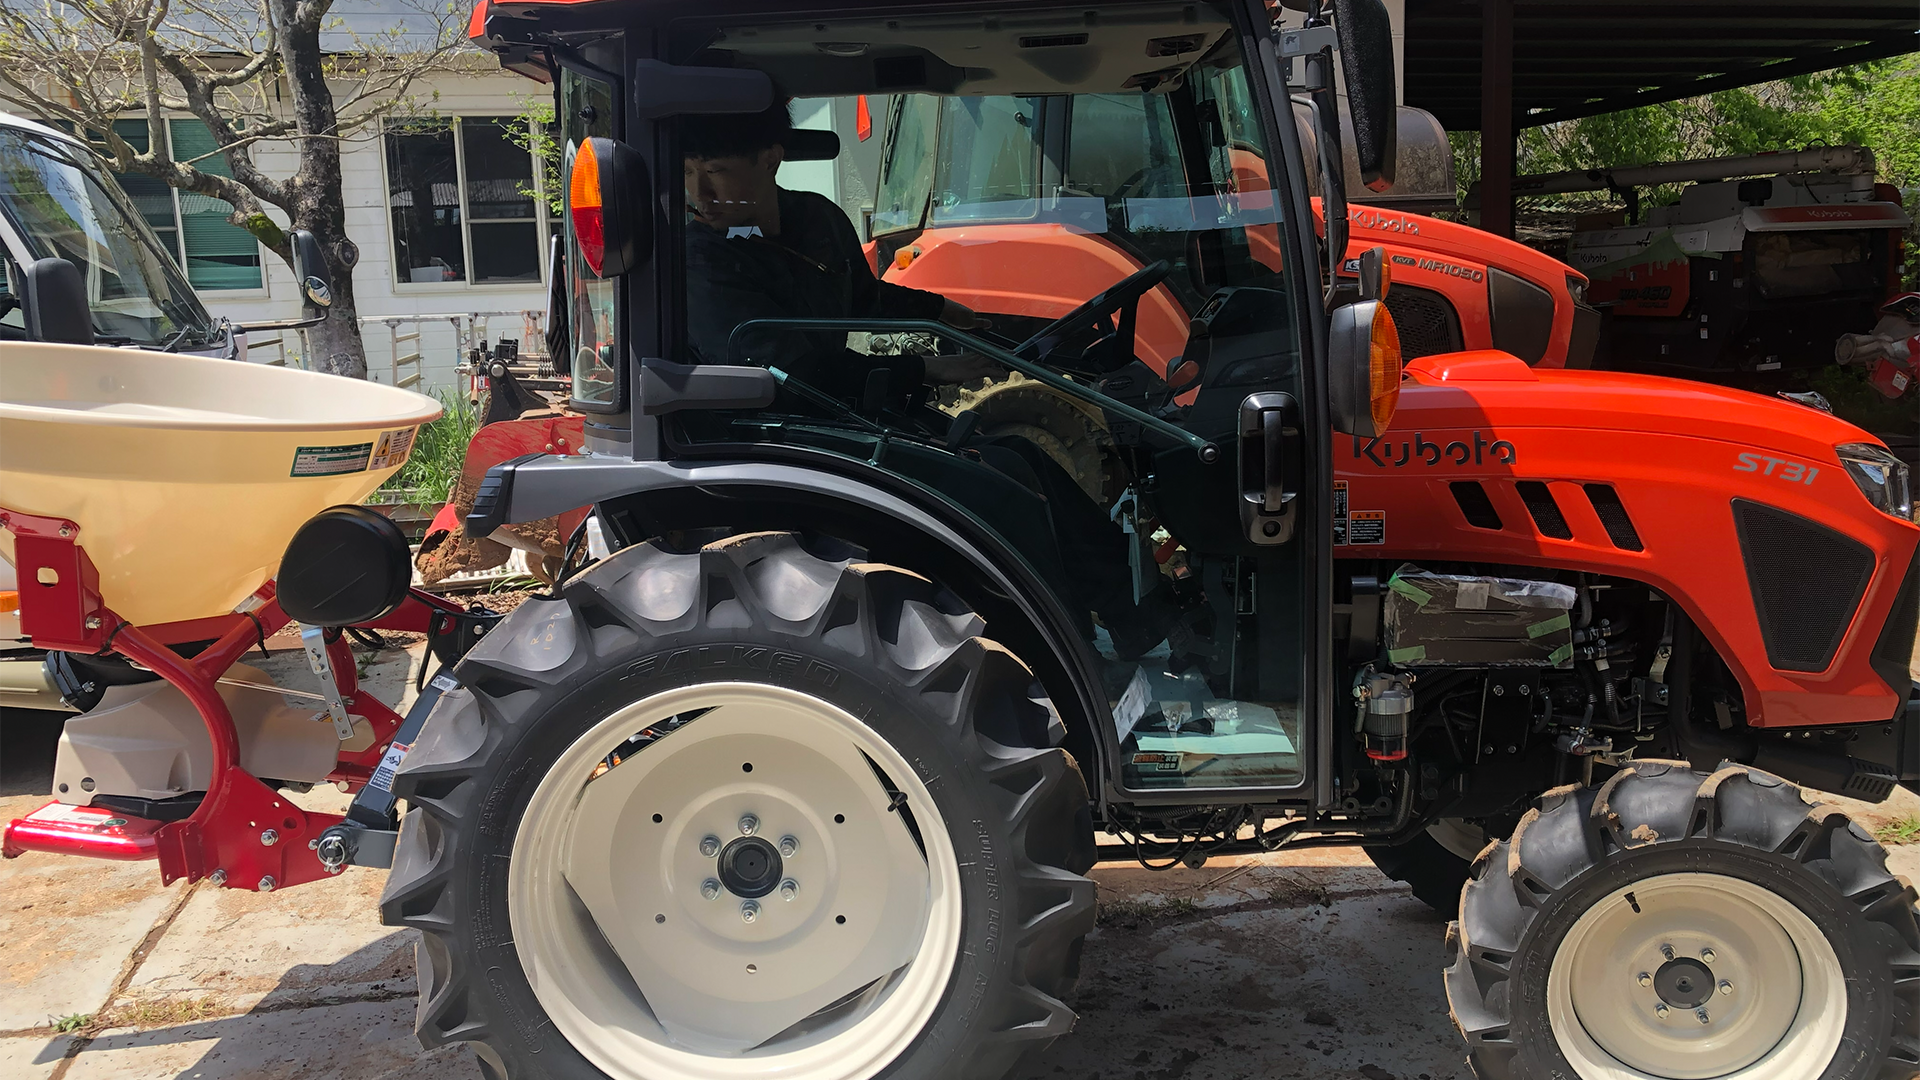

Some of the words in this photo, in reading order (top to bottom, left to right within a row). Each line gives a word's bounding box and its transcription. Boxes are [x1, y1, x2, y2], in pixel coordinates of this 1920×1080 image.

[1350, 210, 1419, 235] Kubota
[1418, 257, 1483, 282] MR1050
[1581, 253, 1607, 263] Kubota
[1353, 431, 1516, 467] Kubota
[1733, 452, 1820, 486] ST31
[972, 819, 999, 901] SUPER
[985, 907, 1000, 954] LUG
